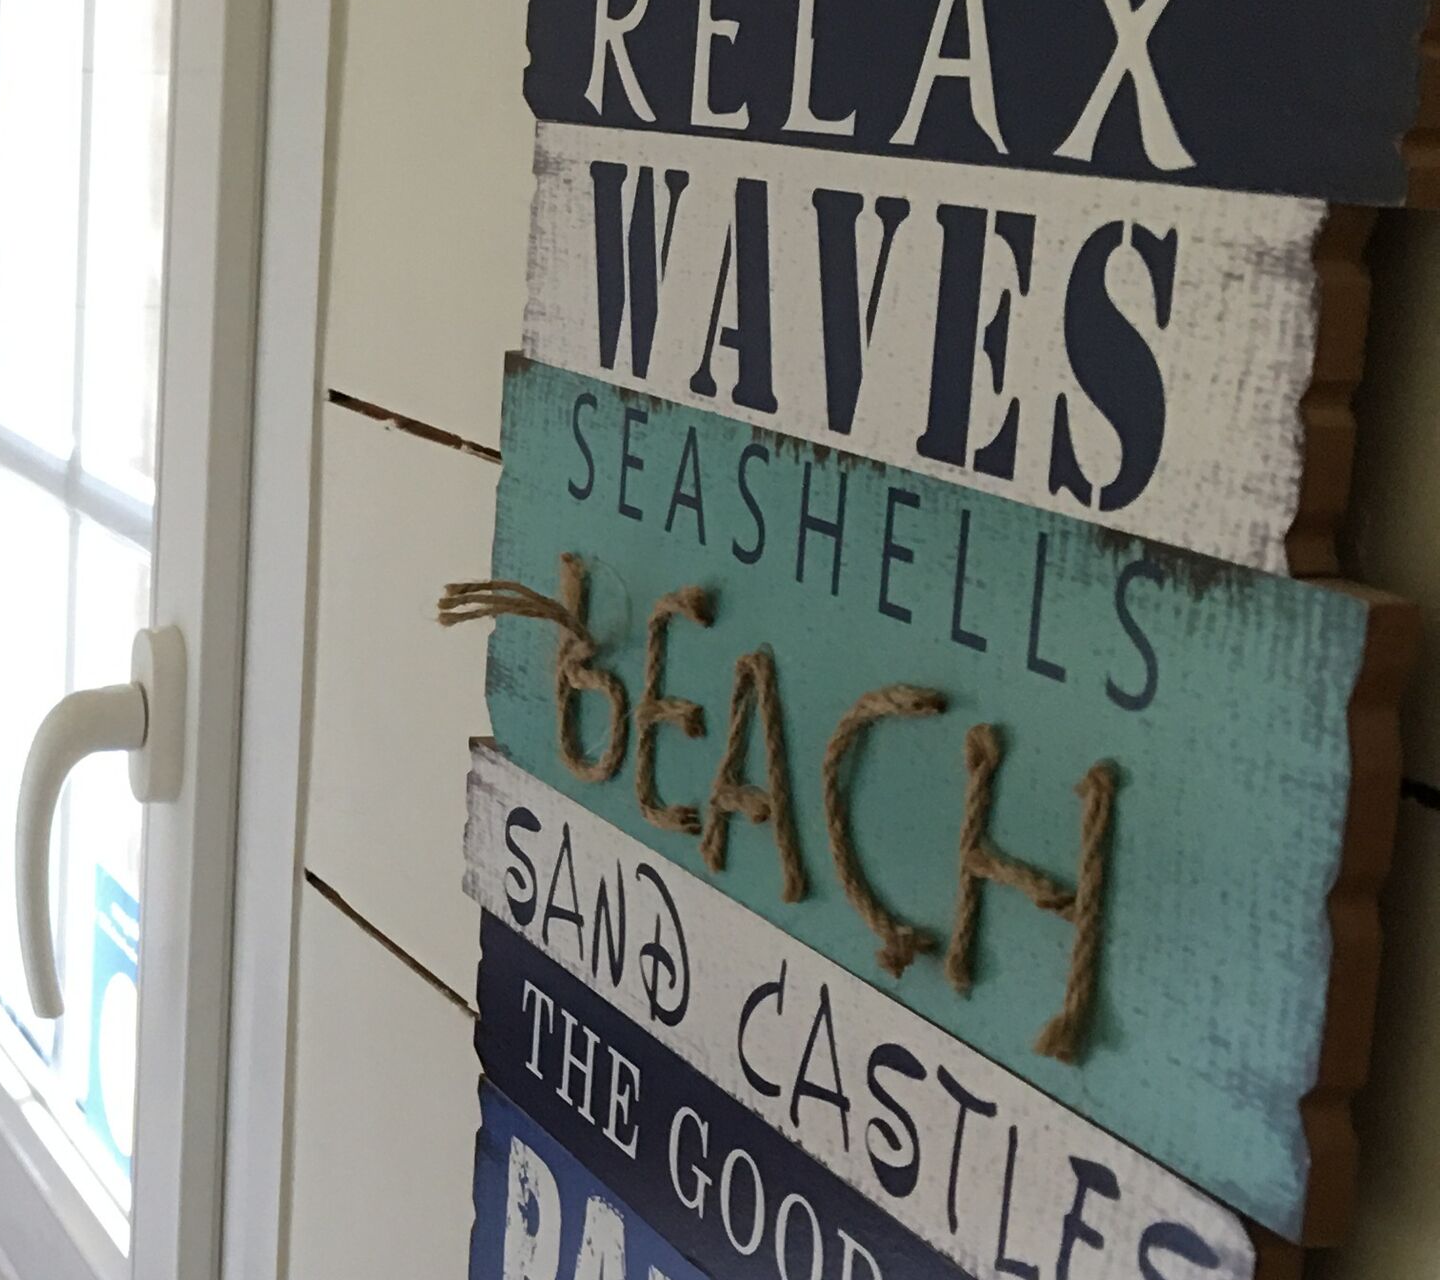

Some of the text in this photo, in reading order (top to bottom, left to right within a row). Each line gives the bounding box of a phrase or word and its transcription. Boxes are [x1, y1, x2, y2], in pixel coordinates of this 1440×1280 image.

[589, 160, 1180, 512] WAVES
[568, 392, 1164, 712] SEASHELLS
[503, 806, 690, 1027] SAND
[556, 551, 1123, 1062] BEACH
[521, 978, 644, 1160] THE
